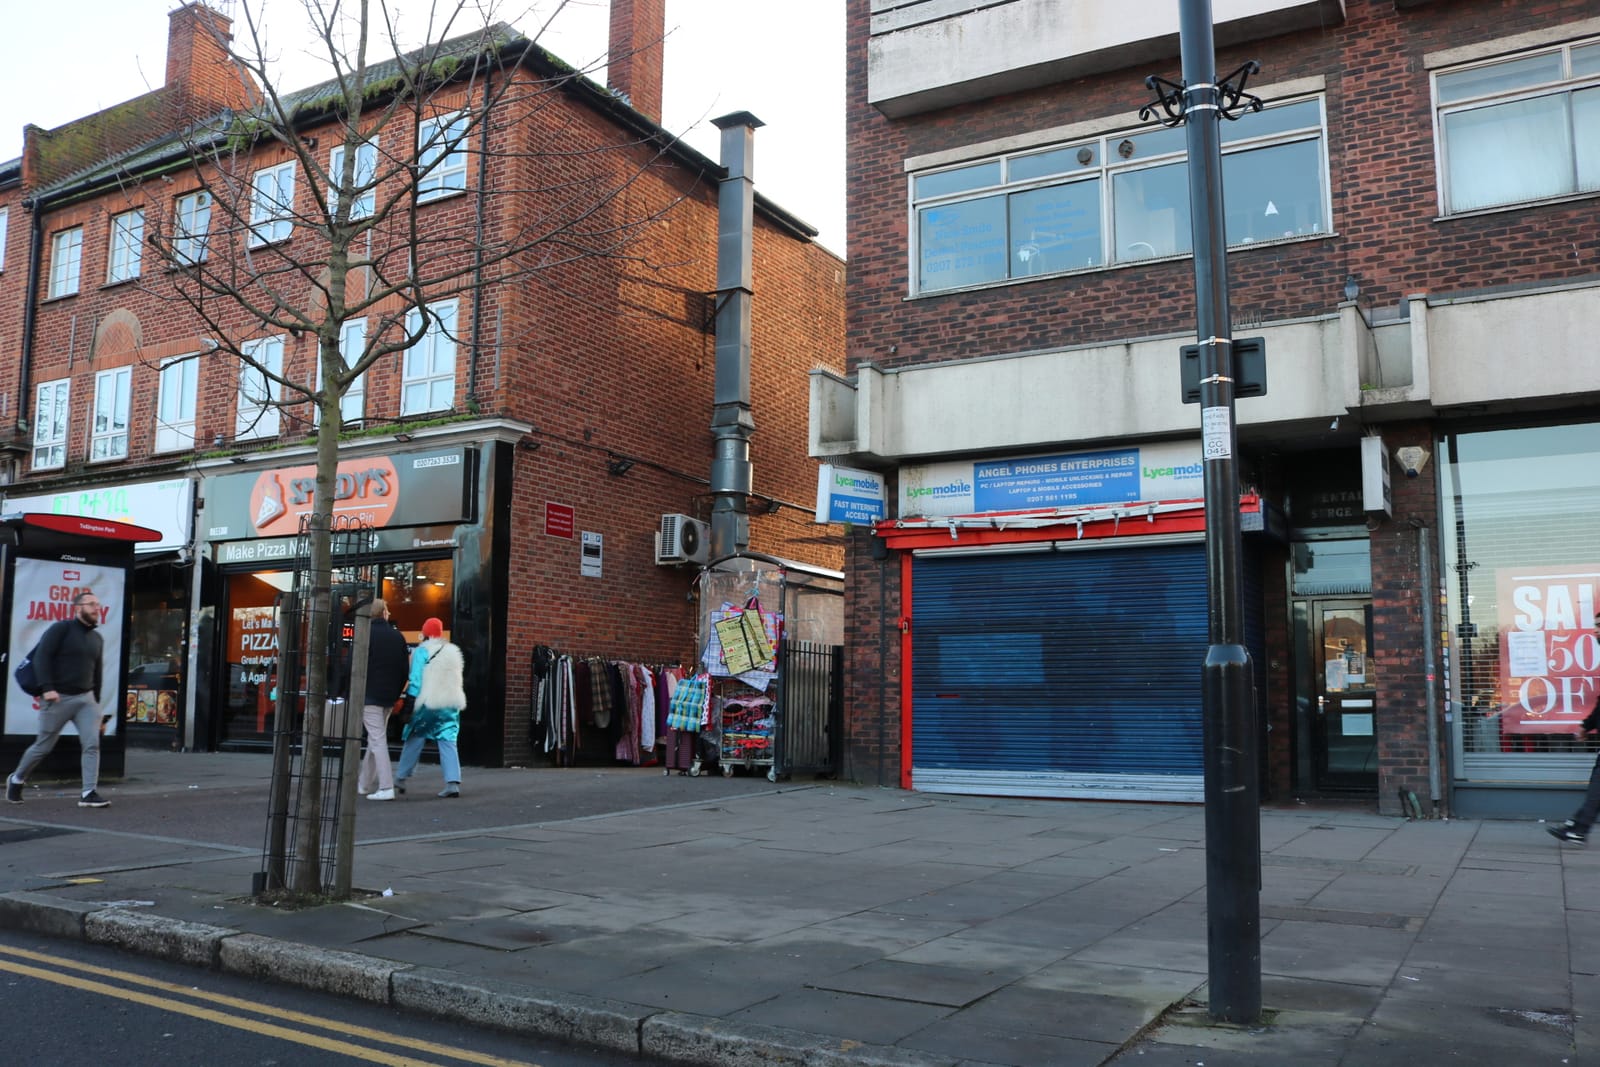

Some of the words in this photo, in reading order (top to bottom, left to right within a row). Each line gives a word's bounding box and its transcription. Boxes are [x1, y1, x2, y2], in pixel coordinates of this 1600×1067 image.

[978, 466, 1012, 478] ANGEL
[1015, 463, 1058, 475] PHONES
[1060, 456, 1136, 472] ENTERPRISES
[1142, 463, 1202, 479] Lycamob
[289, 467, 393, 506] SPDY'S
[835, 473, 880, 490] Lycamobile
[906, 482, 971, 499] Lycamobile
[834, 499, 850, 509] FAST
[850, 501, 881, 513] INTERNET
[844, 510, 869, 521] ACCESS
[226, 544, 255, 561] Make
[257, 541, 287, 558] Pizza
[26, 601, 110, 625] JANUY
[1513, 584, 1595, 632] SAL
[242, 618, 260, 629] Let's
[261, 617, 280, 628] Mae
[241, 632, 279, 651] PIZZA
[240, 655, 258, 665] Great
[1548, 634, 1600, 673] 50
[240, 671, 247, 682] &
[1520, 676, 1600, 715] OF
